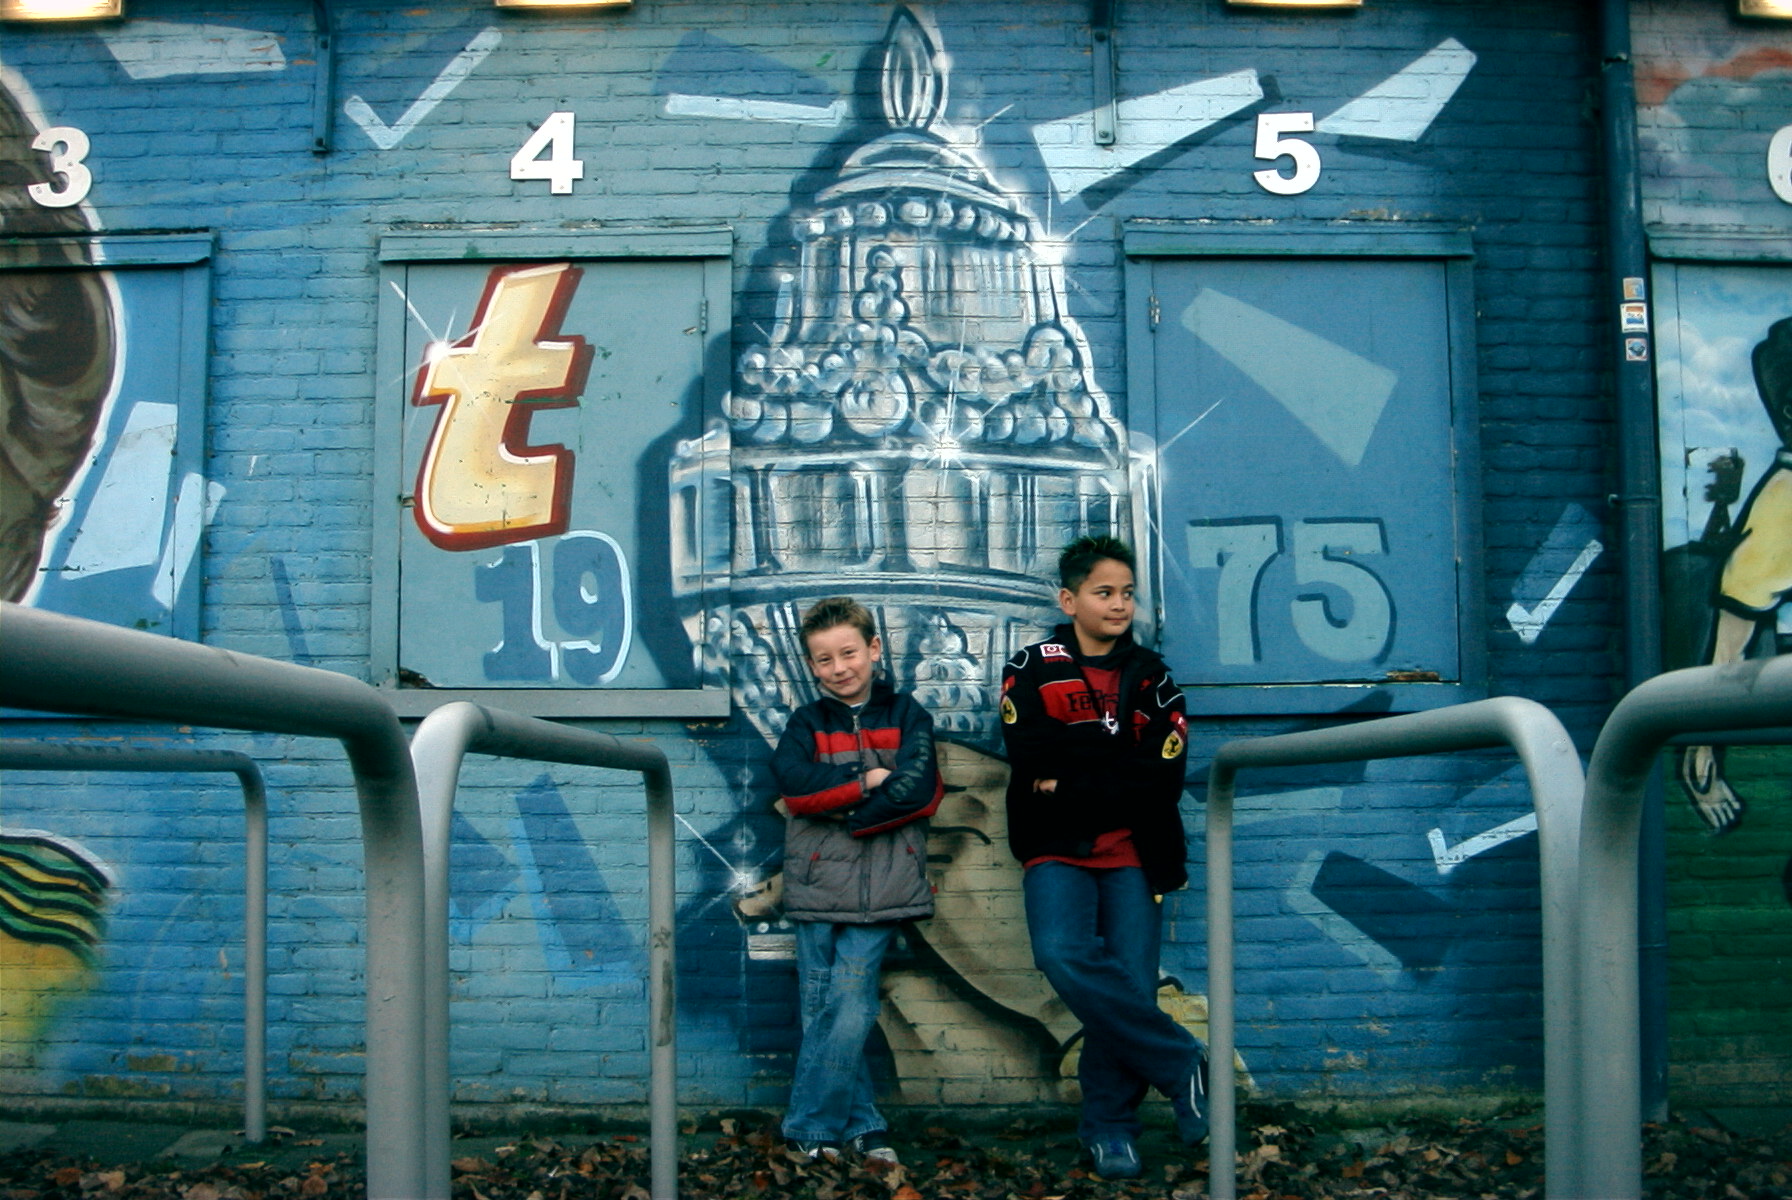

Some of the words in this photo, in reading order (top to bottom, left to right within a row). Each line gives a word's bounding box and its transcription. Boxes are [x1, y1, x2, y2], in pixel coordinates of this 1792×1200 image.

[28, 127, 92, 207] 3
[510, 112, 584, 194] 4
[1253, 112, 1321, 195] 5
[413, 263, 594, 552] t
[475, 529, 633, 686] 19
[1186, 515, 1397, 668] 75
